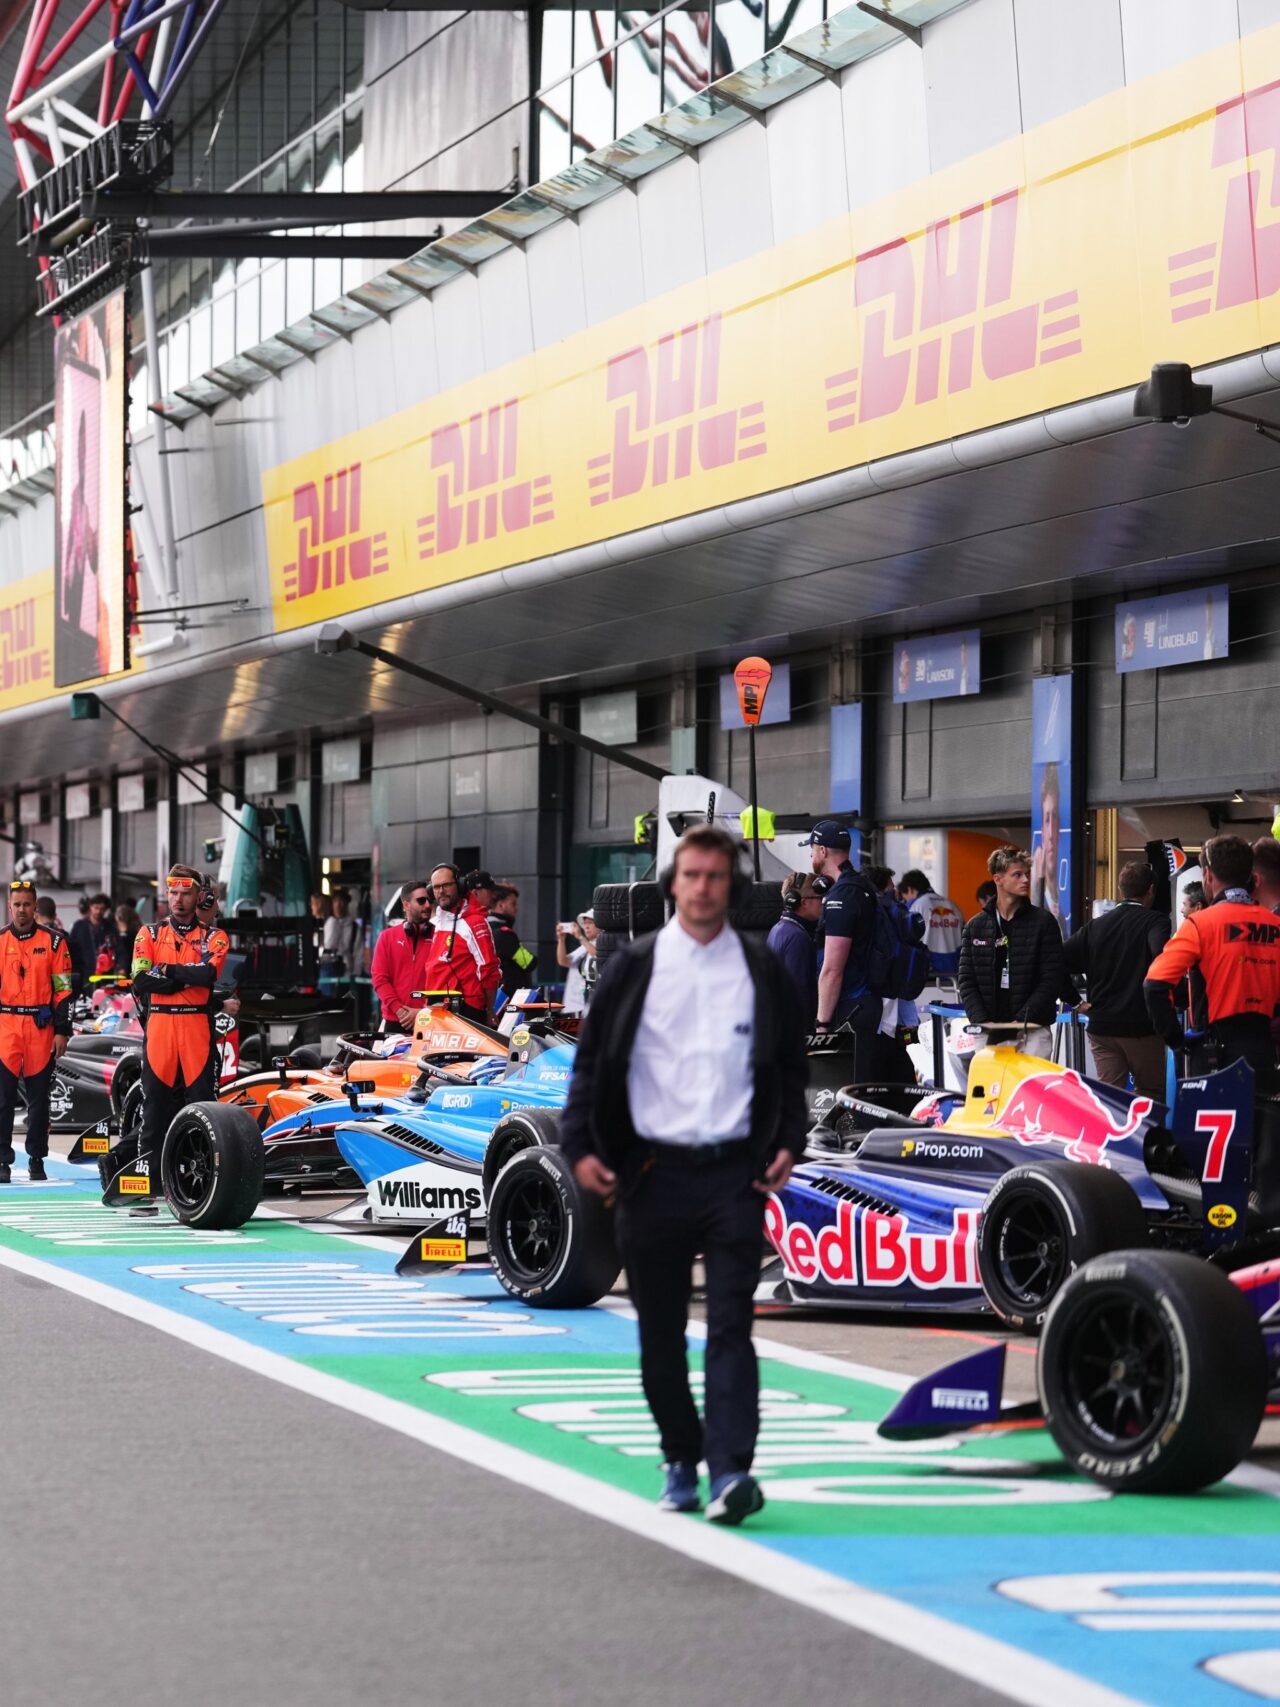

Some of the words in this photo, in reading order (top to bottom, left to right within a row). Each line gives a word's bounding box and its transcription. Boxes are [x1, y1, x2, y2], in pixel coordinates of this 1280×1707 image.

[854, 186, 1040, 423] DHL
[606, 312, 738, 500] DHL
[430, 397, 532, 555] DHL
[293, 462, 372, 600] DHL
[1158, 631, 1198, 649] LINDBLAD
[194, 1110, 217, 1143] ZERO
[84, 1140, 107, 1151] PIRELLI
[915, 1142, 984, 1159] Prop.com
[1195, 1110, 1237, 1182] 7
[122, 1179, 148, 1191] PIRELLI
[377, 1180, 481, 1209] Williams
[425, 1243, 462, 1257] PIRELLI
[932, 1388, 989, 1411] PIRELLI
[1077, 1451, 1143, 1478] ZERO
